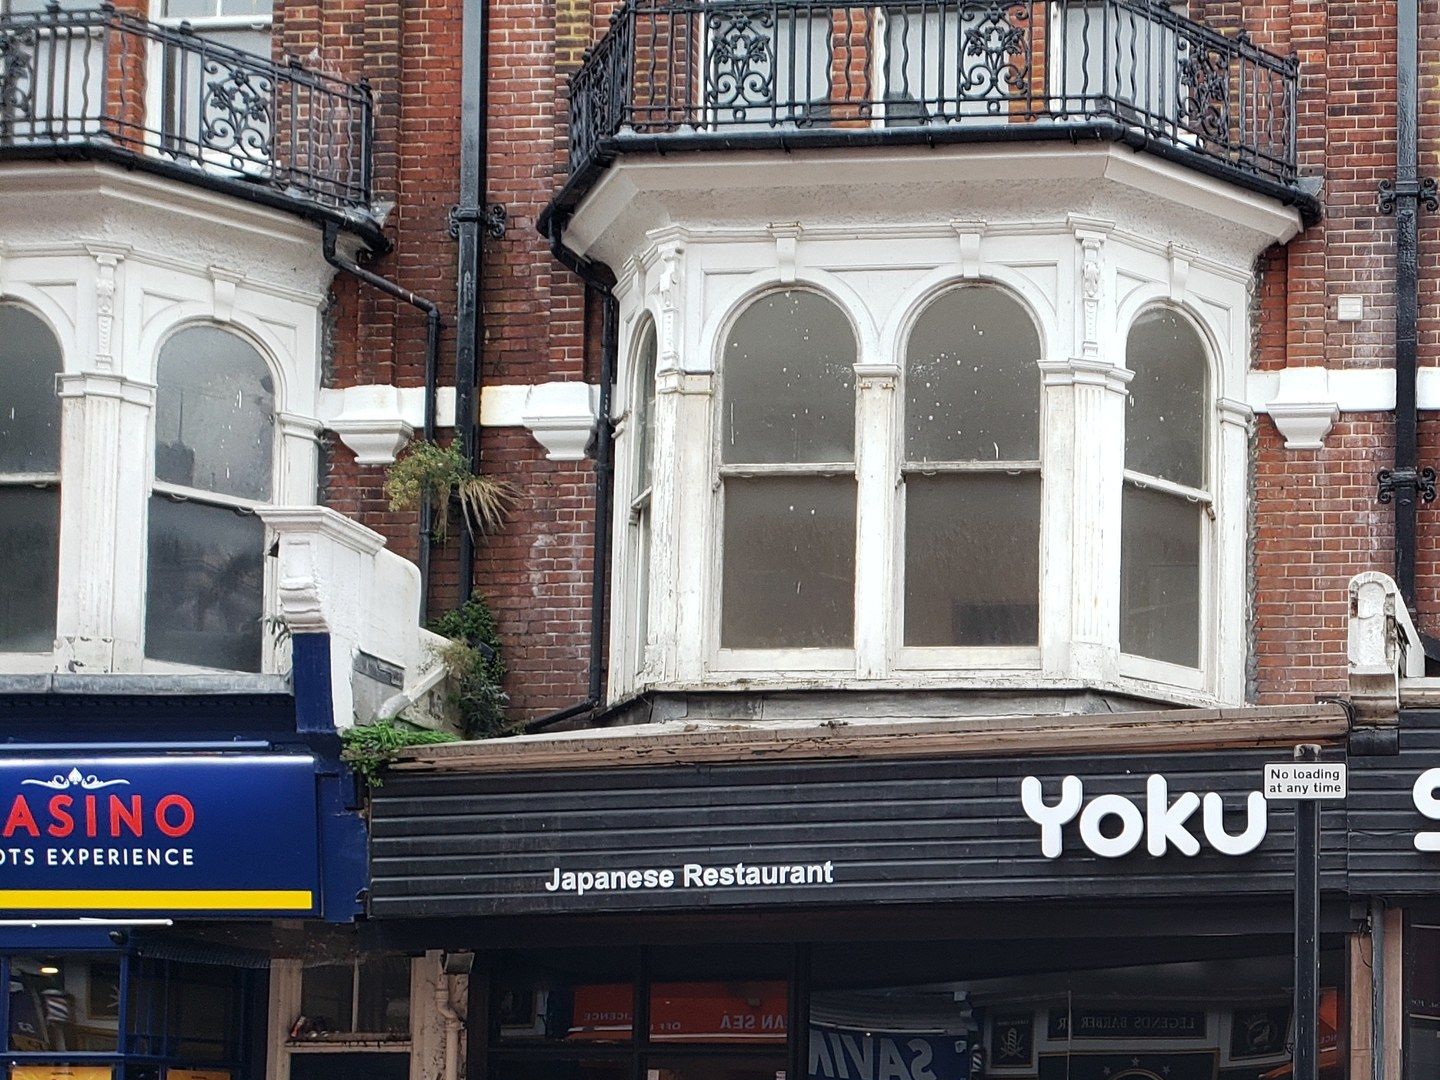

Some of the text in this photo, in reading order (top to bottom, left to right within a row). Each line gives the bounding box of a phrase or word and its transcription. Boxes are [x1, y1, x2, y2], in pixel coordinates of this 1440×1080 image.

[1270, 769, 1340, 781] No loading
[1269, 783, 1341, 795] at any time
[1021, 774, 1268, 858] Yoku
[47, 848, 194, 866] EXPERIENCE
[545, 860, 834, 895] Japanese Restaurant
